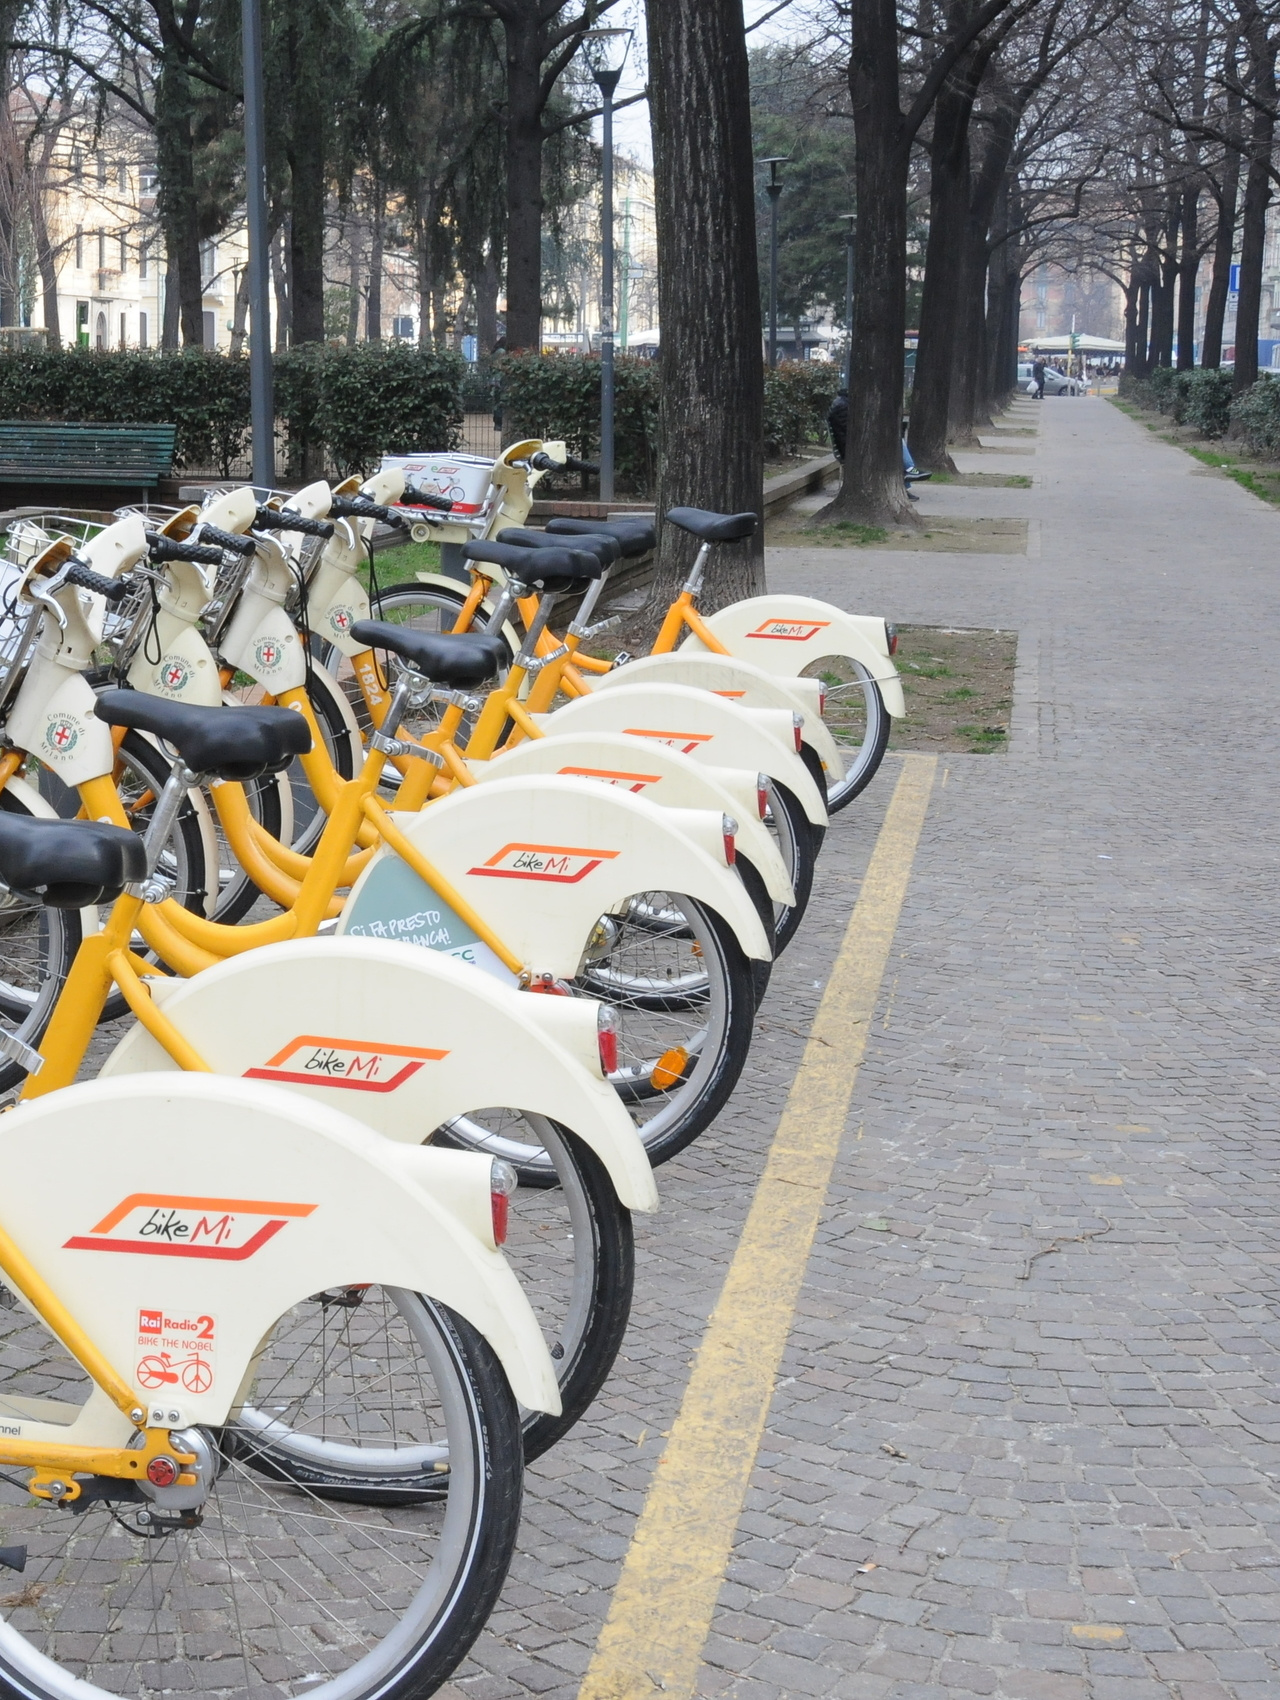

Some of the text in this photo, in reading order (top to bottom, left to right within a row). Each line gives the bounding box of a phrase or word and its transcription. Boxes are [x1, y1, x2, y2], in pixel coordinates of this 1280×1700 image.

[325, 604, 347, 620] Comune
[252, 636, 280, 647] Comune
[163, 655, 196, 678] Comune di
[254, 663, 283, 675] Milano
[154, 679, 183, 698] Milano
[359, 663, 383, 706] 1824
[47, 712, 86, 736] Comune di
[40, 741, 74, 761] Milano
[513, 852, 571, 874] bikeMi
[389, 910, 441, 936] PRESTO
[304, 1048, 383, 1079] bikeMi
[139, 1208, 235, 1245] bikeMi
[141, 1316, 161, 1328] Rai
[138, 1336, 214, 1352] BIKE THE NOBEL
